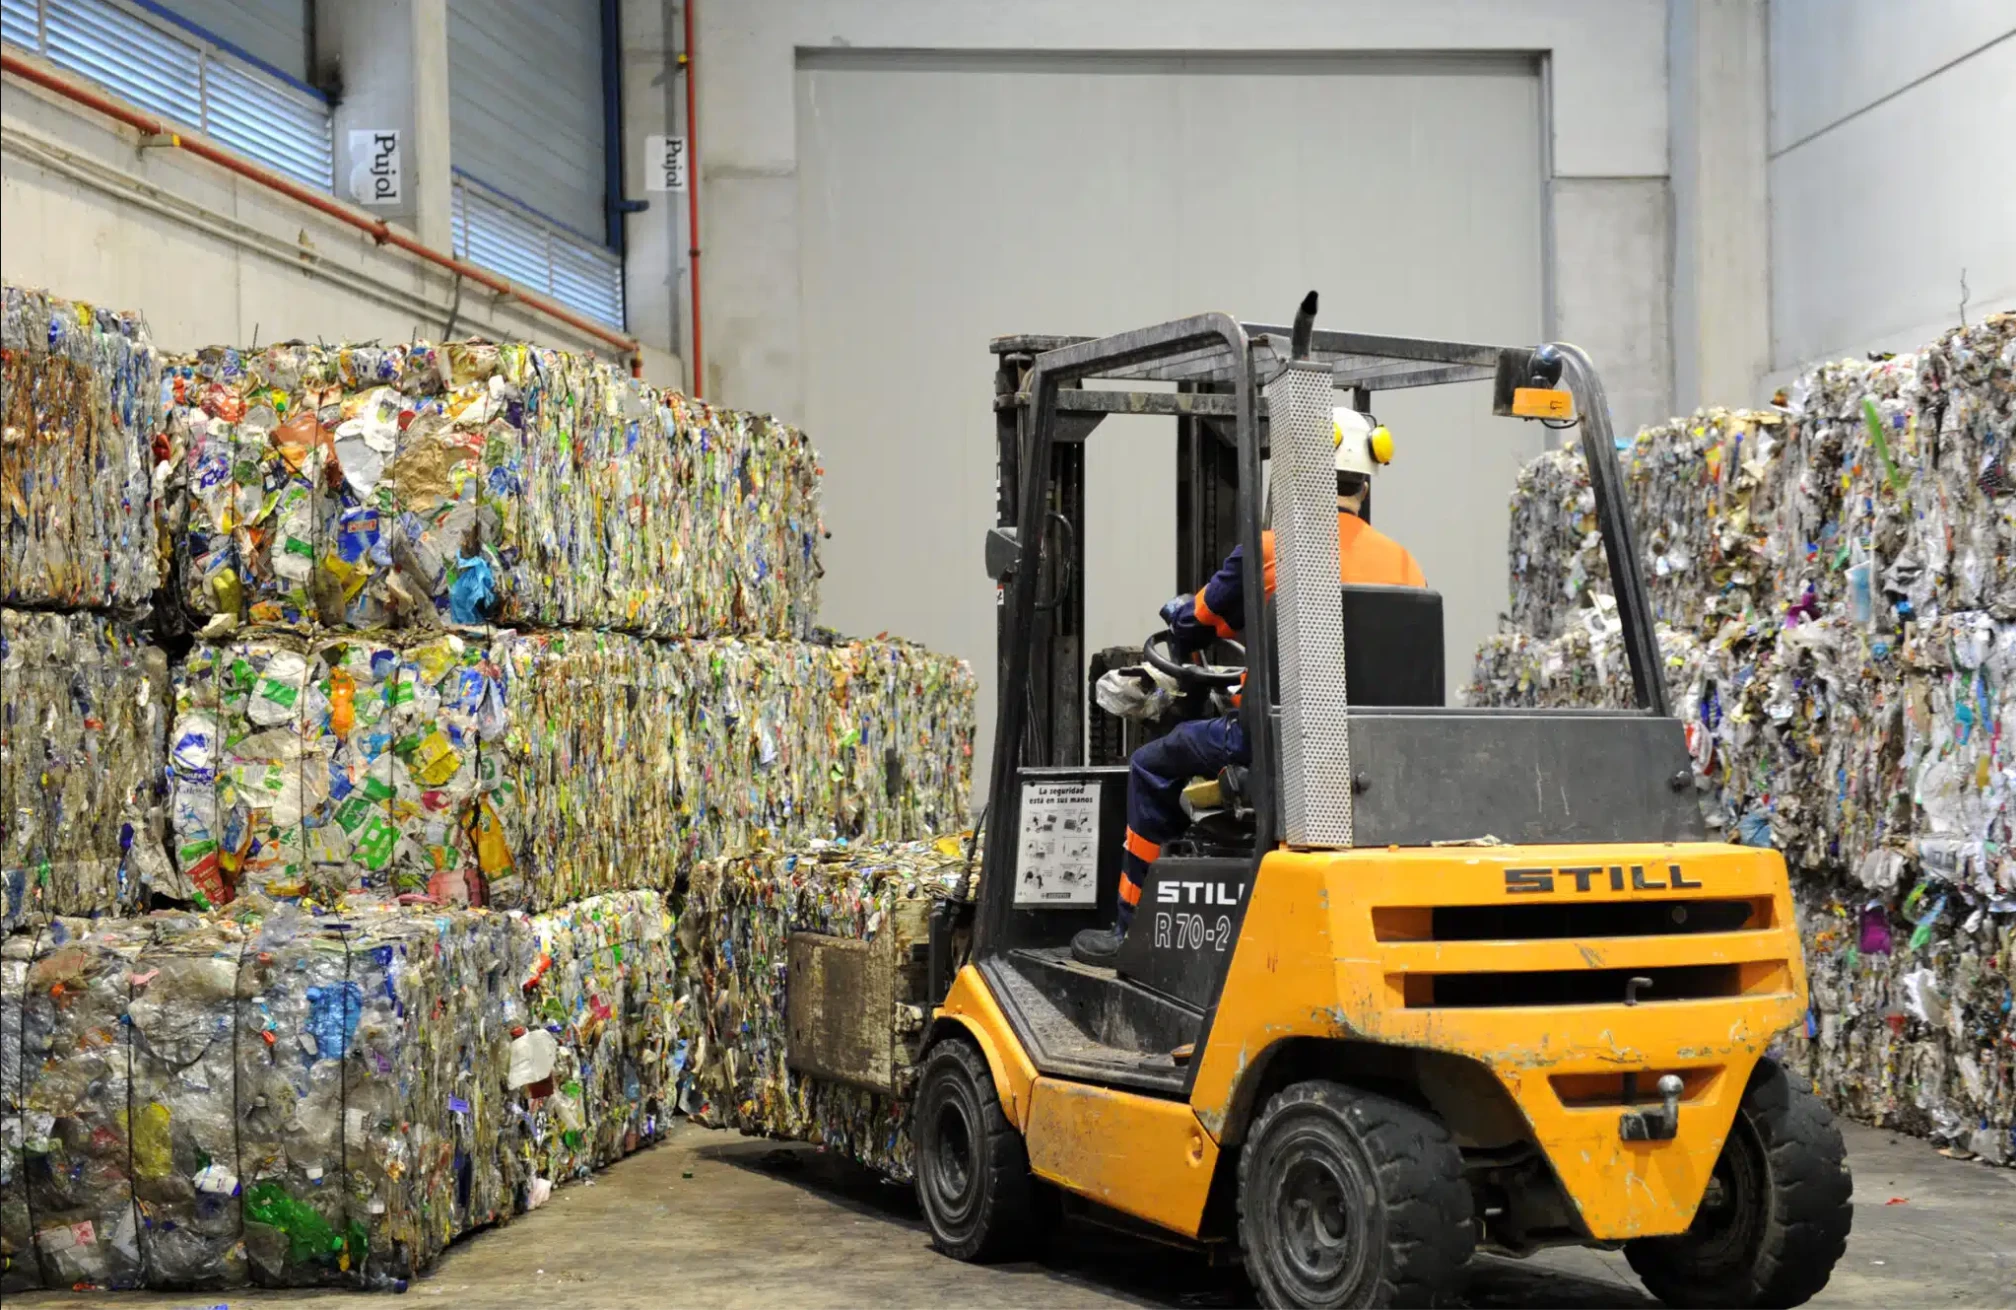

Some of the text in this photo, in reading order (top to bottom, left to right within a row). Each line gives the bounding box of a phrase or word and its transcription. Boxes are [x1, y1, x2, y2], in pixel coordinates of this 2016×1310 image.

[370, 133, 397, 200] Pujol
[661, 139, 683, 189] Pujol
[1039, 787, 1085, 796] La seguridad
[1057, 796, 1068, 804] sus
[1069, 796, 1093, 804] manos
[1503, 865, 1702, 894] STILL
[1155, 912, 1172, 949] R
